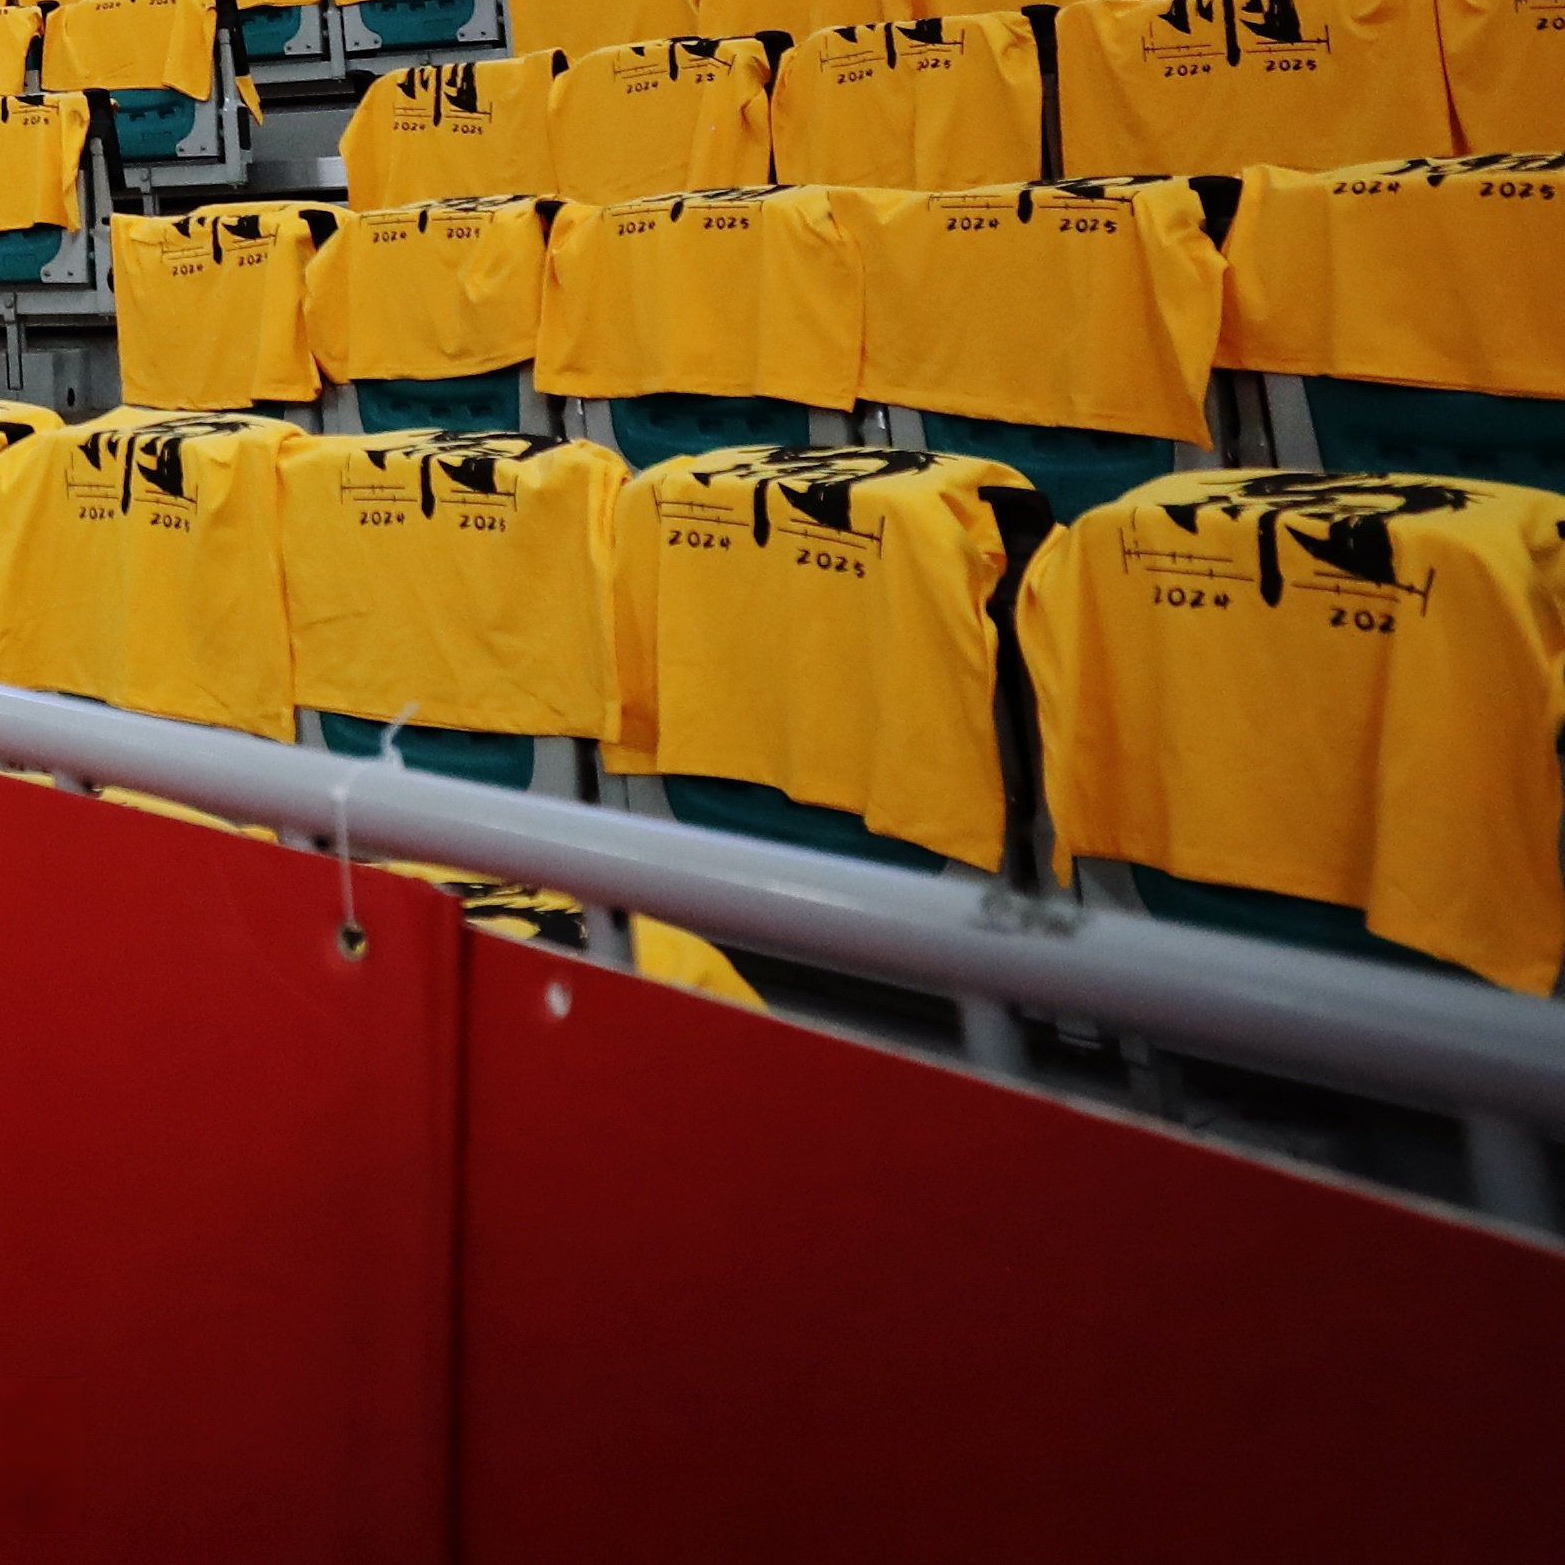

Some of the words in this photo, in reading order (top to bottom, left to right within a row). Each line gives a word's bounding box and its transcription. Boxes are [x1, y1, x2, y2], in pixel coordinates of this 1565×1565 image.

[838, 70, 872, 84] 2024
[1164, 64, 1211, 77] 2024
[1265, 59, 1317, 71] 2025
[1333, 181, 1401, 195] 2024
[1480, 182, 1555, 200] 2025
[618, 222, 656, 236] 2024
[703, 217, 750, 229] 2025
[947, 217, 1000, 231] 2024
[1060, 218, 1118, 233] 2025
[79, 507, 114, 520] 2024
[151, 513, 191, 533] 2025
[360, 512, 405, 525] 2024
[459, 515, 506, 532] 2025
[668, 530, 731, 550] 2024
[796, 549, 865, 579] 2025
